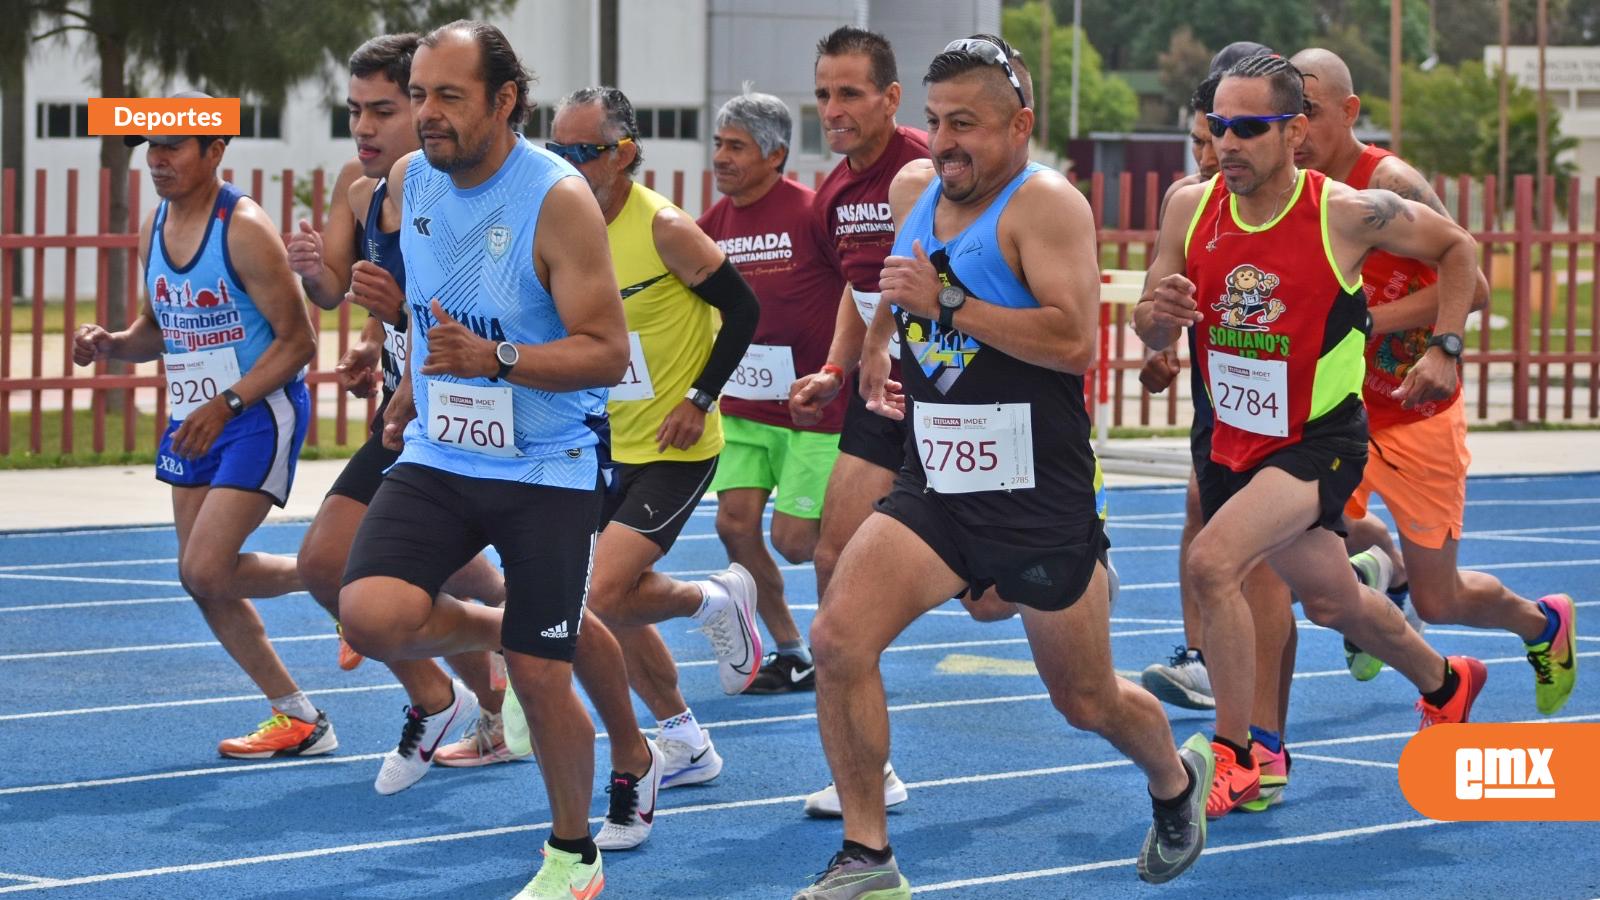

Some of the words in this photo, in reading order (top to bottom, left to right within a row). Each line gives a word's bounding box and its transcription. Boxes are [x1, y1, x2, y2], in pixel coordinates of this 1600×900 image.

[729, 249, 793, 264] YUNTAMIENTO
[412, 303, 507, 341] TIANA
[181, 327, 244, 352] Tijuana
[1209, 325, 1290, 356] SORIANO'S
[728, 365, 773, 388] 839
[170, 377, 218, 405] 920
[1218, 382, 1279, 419] 2784
[437, 414, 505, 449] 2760
[934, 418, 960, 426] TIJUANA
[922, 439, 998, 473] 2785
[1011, 476, 1029, 485] 2785
[540, 630, 569, 639] adidas
